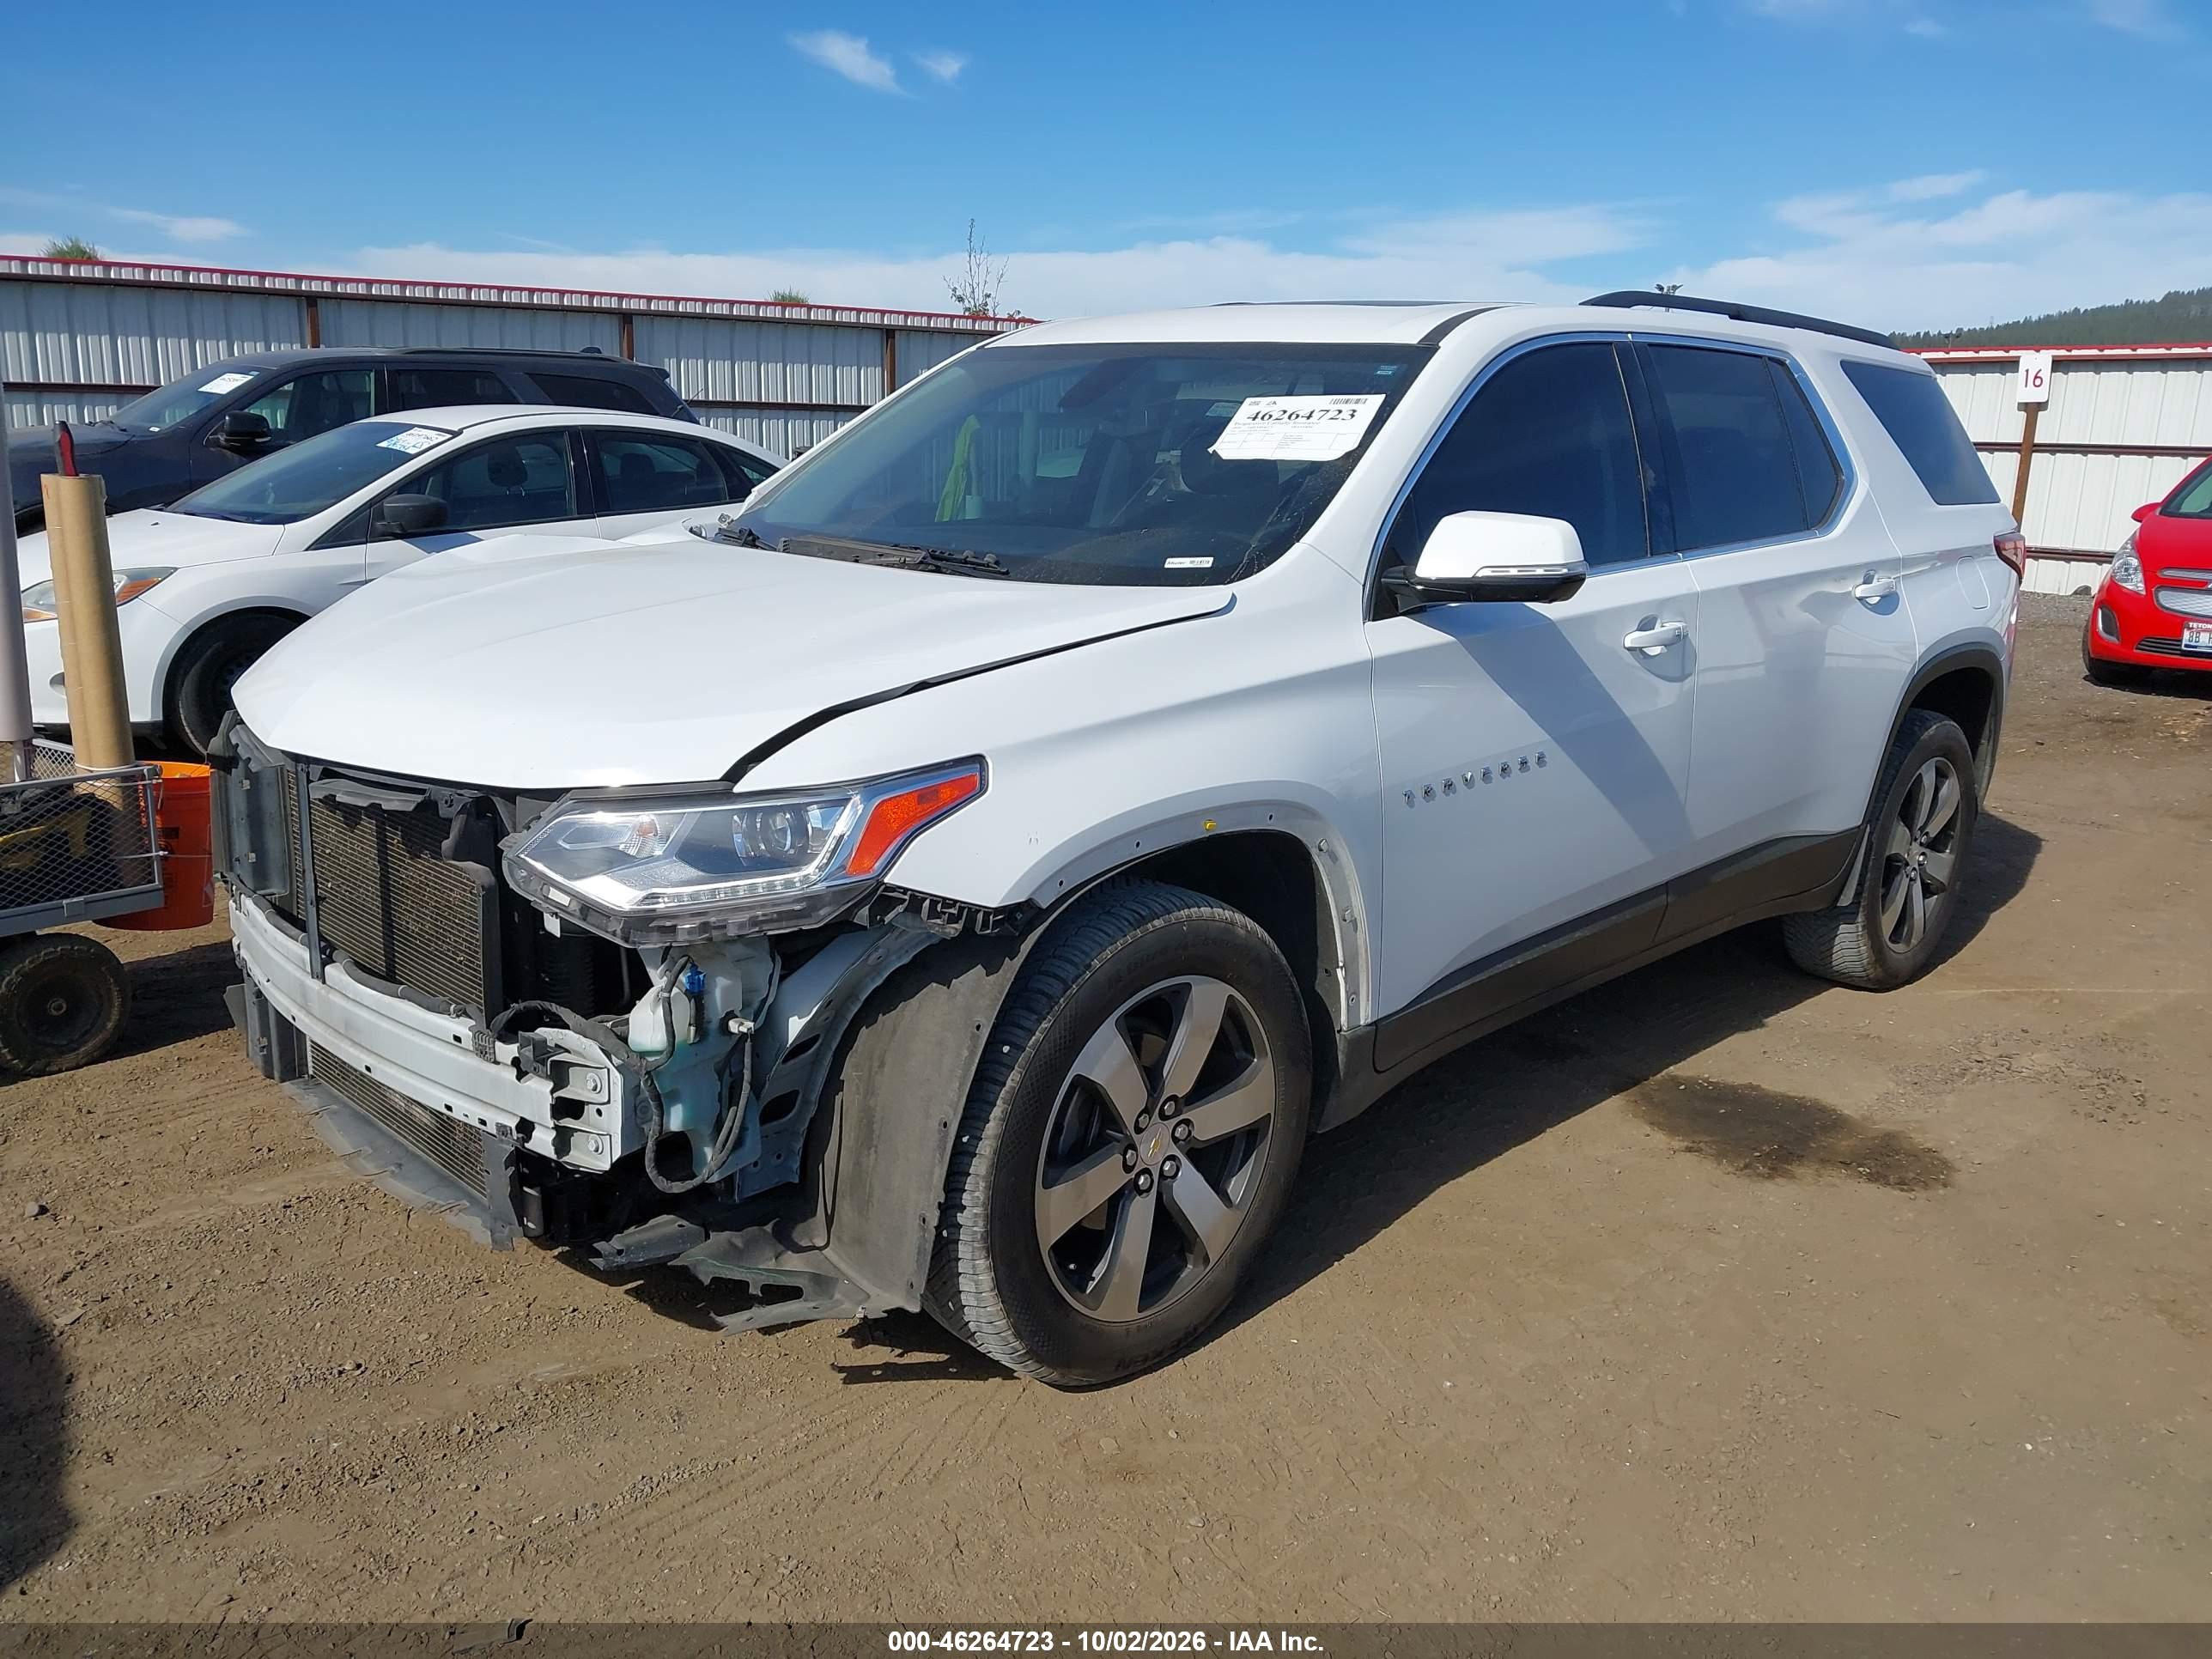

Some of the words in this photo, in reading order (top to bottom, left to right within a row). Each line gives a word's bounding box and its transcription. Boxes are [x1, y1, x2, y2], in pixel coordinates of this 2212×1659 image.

[2025, 368, 2044, 388] 16
[1247, 409, 1358, 422] 46264723
[1402, 751, 1547, 805] TRAVERSE
